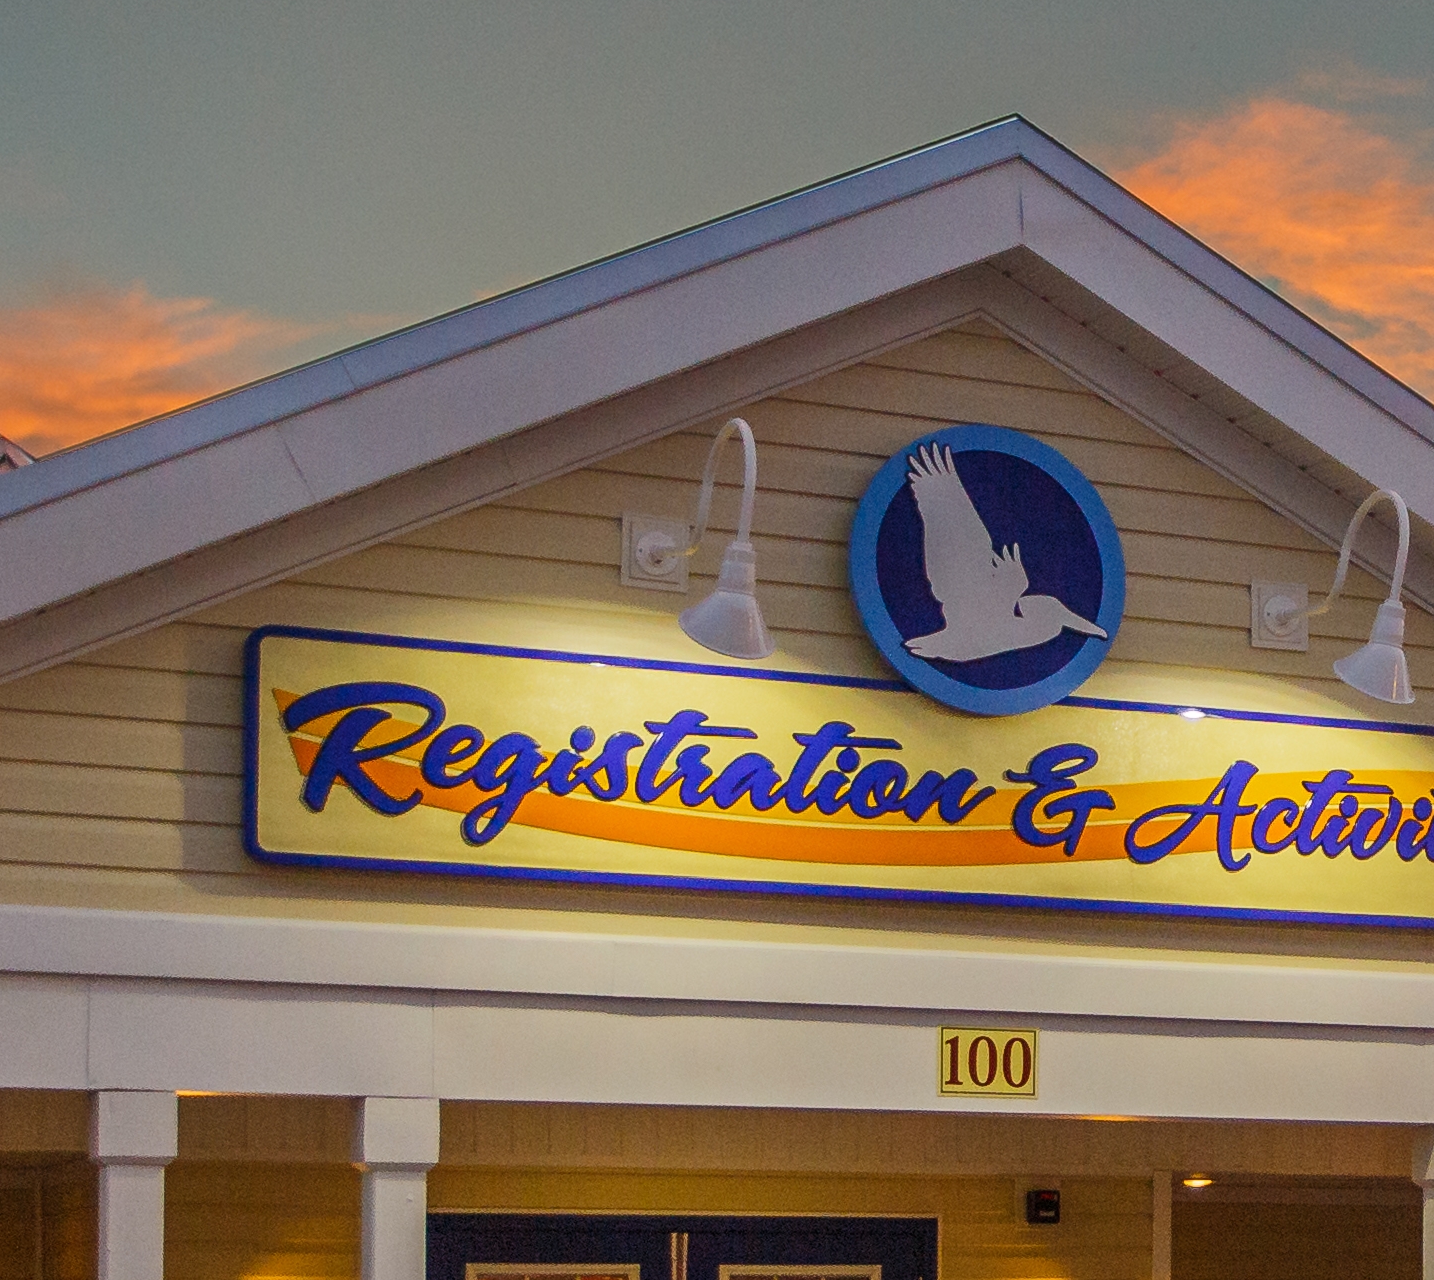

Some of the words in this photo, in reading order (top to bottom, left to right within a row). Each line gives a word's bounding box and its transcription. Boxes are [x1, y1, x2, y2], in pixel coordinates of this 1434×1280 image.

[282, 682, 996, 845] Registration
[1004, 743, 1115, 857] &
[945, 1034, 1034, 1089] 100
